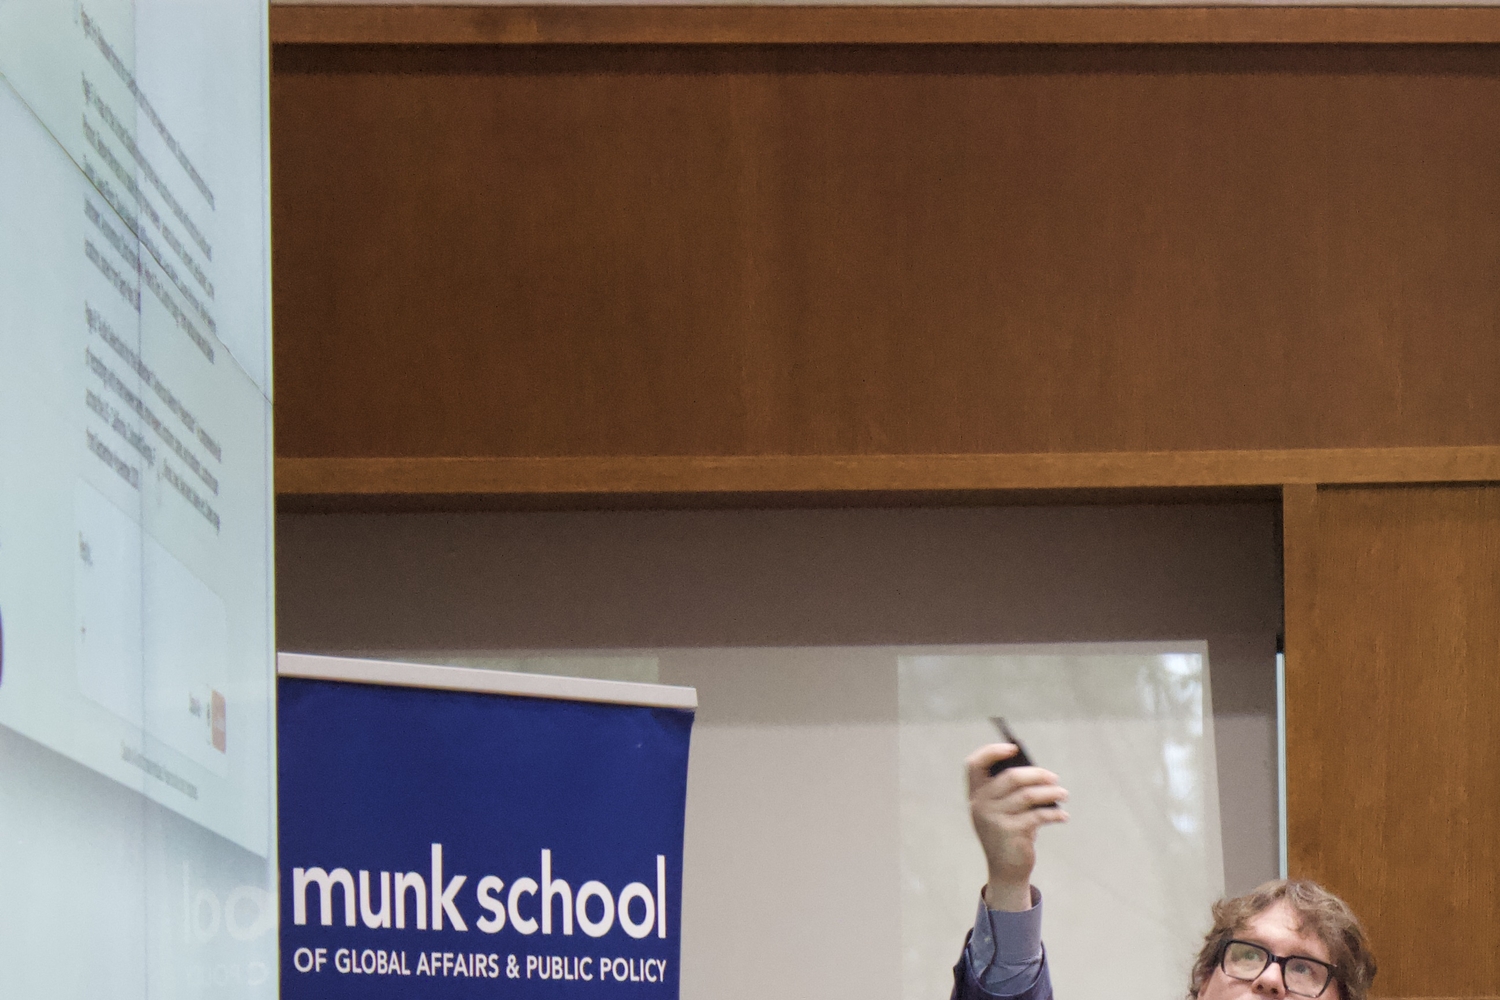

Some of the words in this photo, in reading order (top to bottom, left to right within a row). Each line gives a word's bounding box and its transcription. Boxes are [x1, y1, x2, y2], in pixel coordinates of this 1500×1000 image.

[292, 843, 469, 932] munk
[476, 848, 667, 939] school
[293, 947, 328, 973] OF
[334, 948, 411, 976] GLOBAL
[416, 951, 500, 979] AFFAIRS
[505, 954, 520, 979] &
[526, 955, 594, 982] PUBLIC
[599, 957, 667, 983] POLICY
